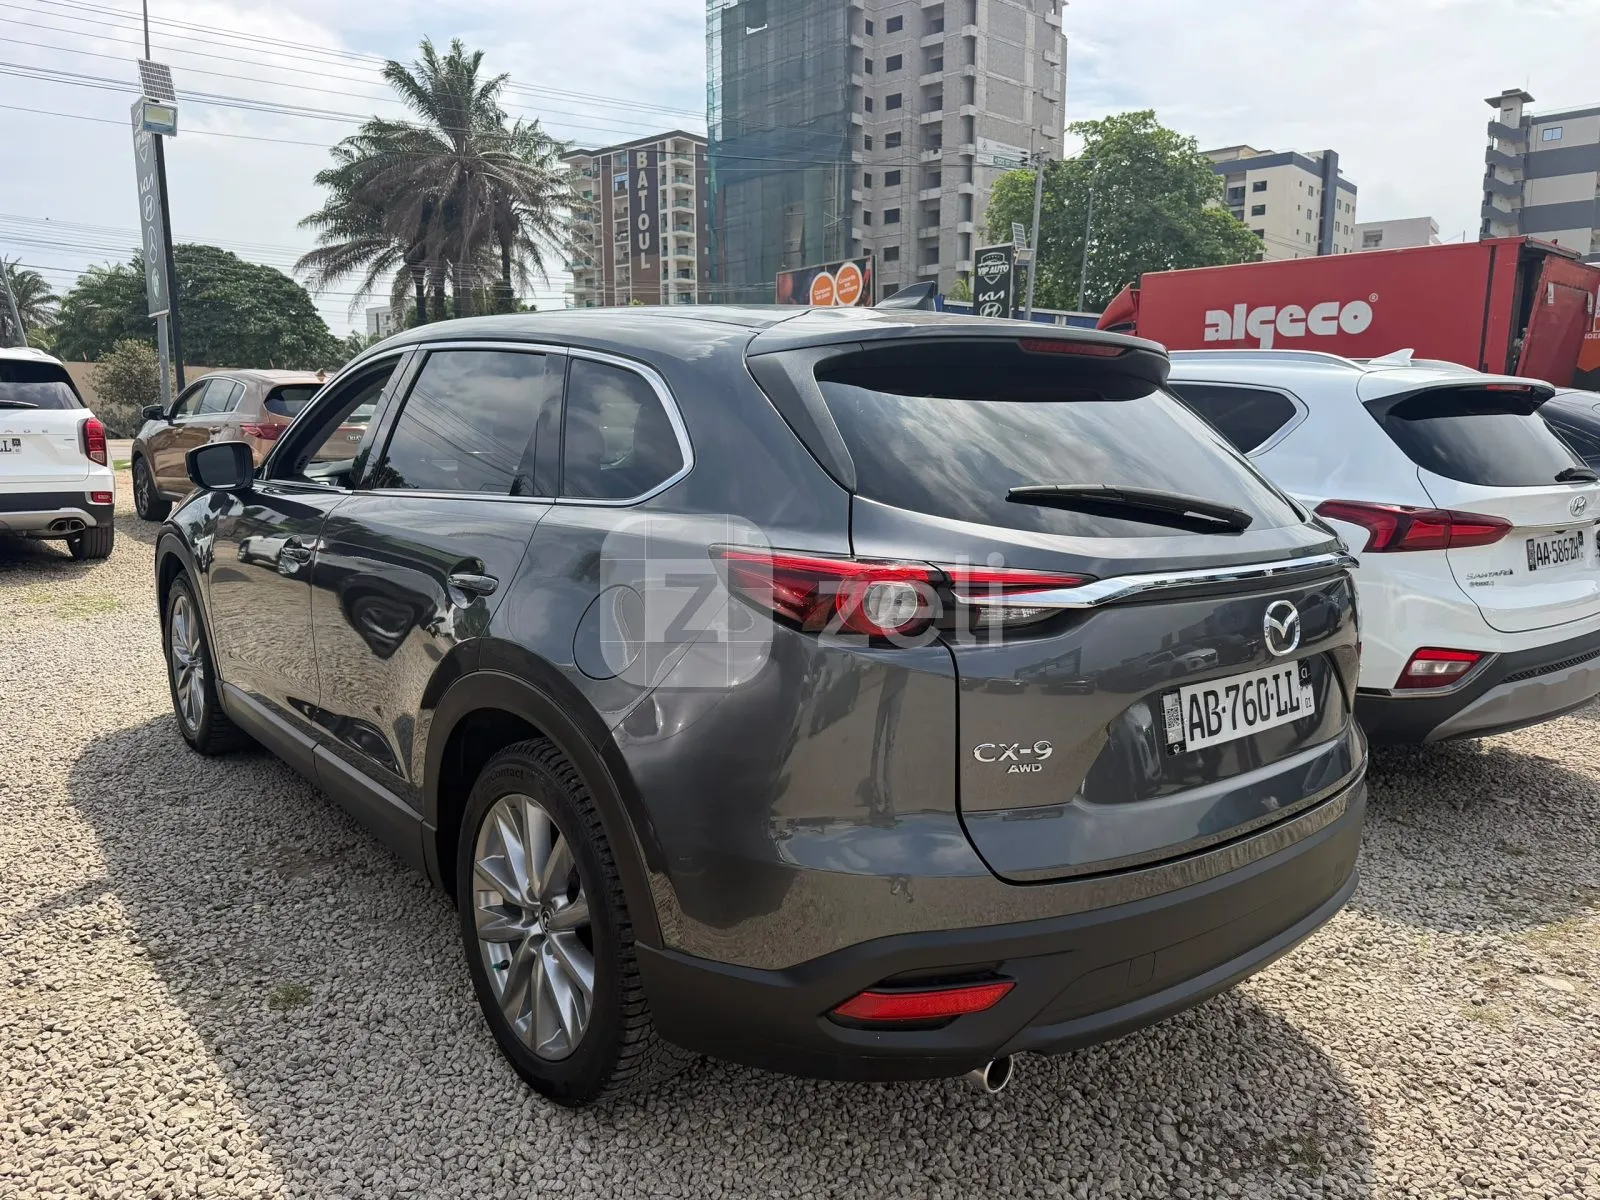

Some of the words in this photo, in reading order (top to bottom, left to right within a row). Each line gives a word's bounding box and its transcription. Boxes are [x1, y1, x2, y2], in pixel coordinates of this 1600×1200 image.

[636, 151, 651, 270] BATOUL
[977, 267, 990, 276] VIP
[988, 264, 1010, 274] AUTO
[1203, 300, 1373, 350] algeco
[973, 740, 1053, 762] CX-9
[1007, 763, 1043, 774] AWD
